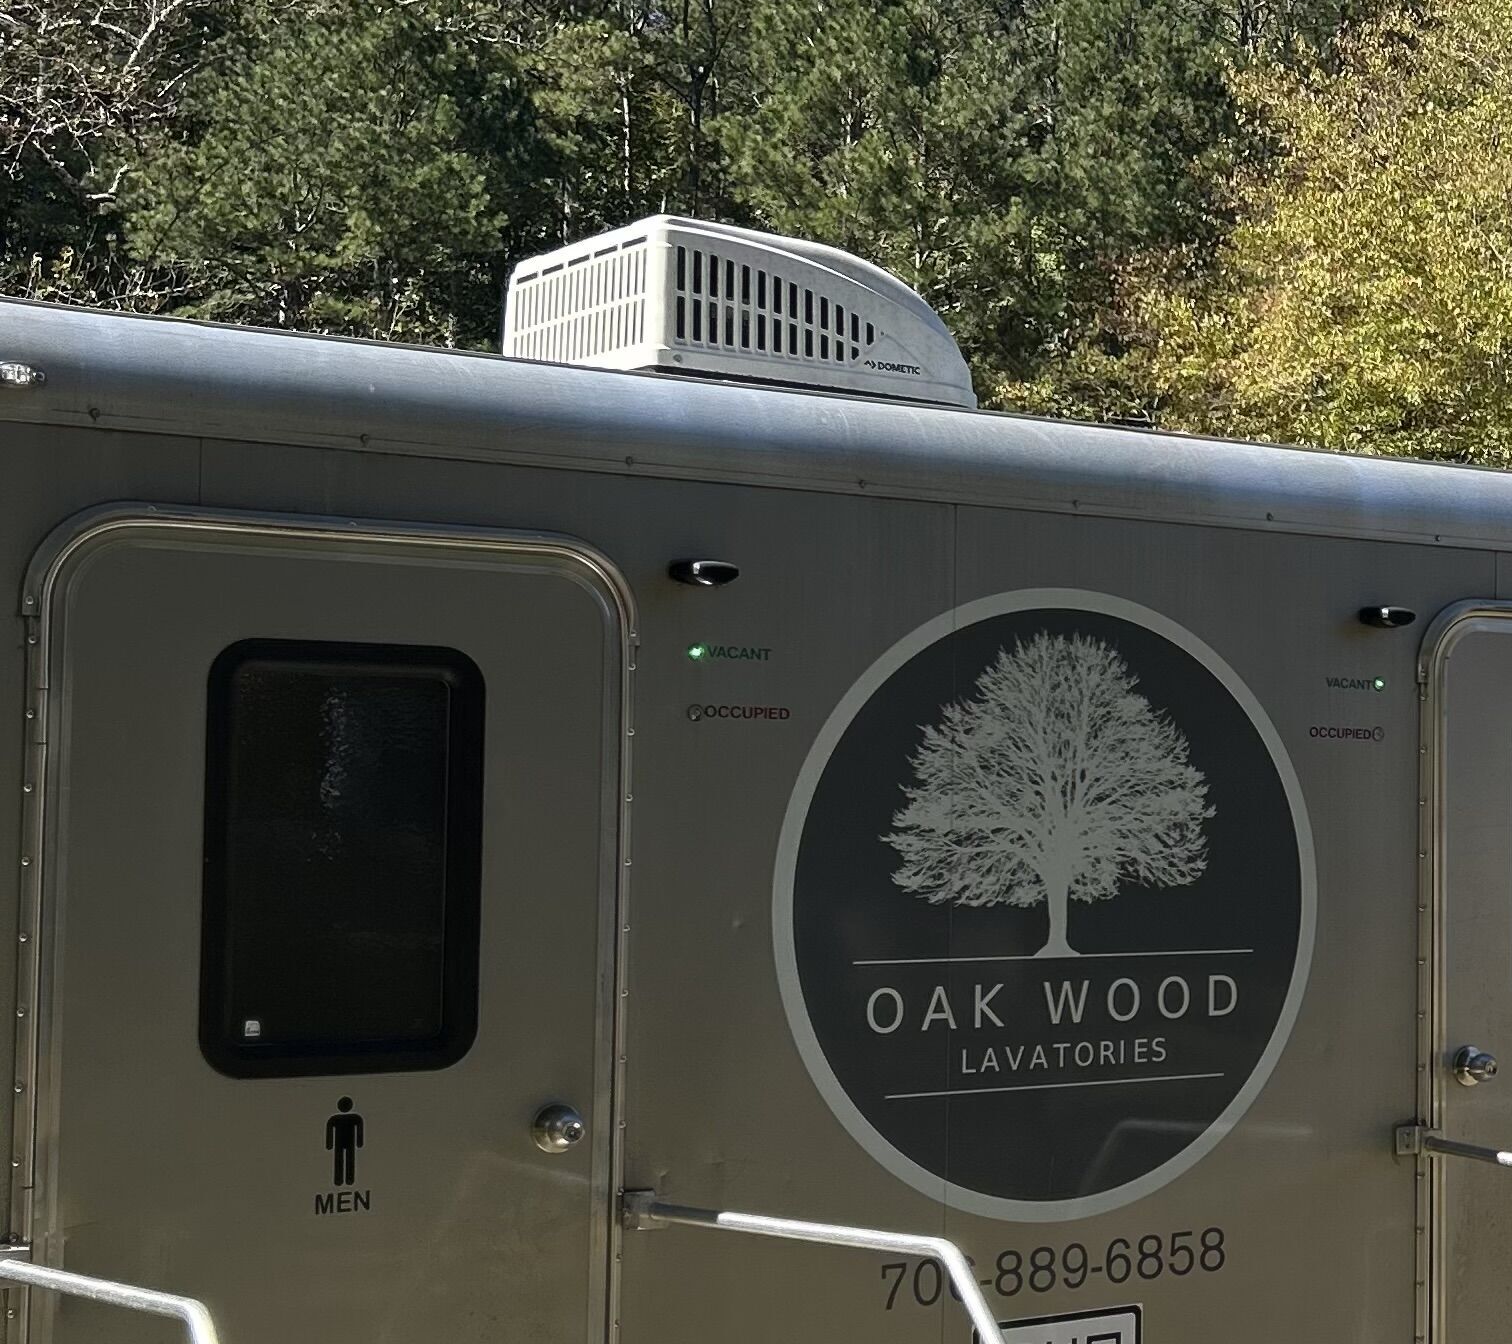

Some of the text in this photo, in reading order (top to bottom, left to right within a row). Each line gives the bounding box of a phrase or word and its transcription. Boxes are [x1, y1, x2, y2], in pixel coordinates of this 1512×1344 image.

[877, 362, 921, 375] DOMETIC
[707, 645, 772, 661] VACANT
[1326, 677, 1372, 690] VACANT
[704, 705, 790, 720] OCCUPIED
[1309, 726, 1372, 740] OCCUPIED
[866, 974, 1238, 1034] OAK WOOD
[961, 1037, 1167, 1074] LAVATORIES
[314, 1189, 371, 1215] MEN
